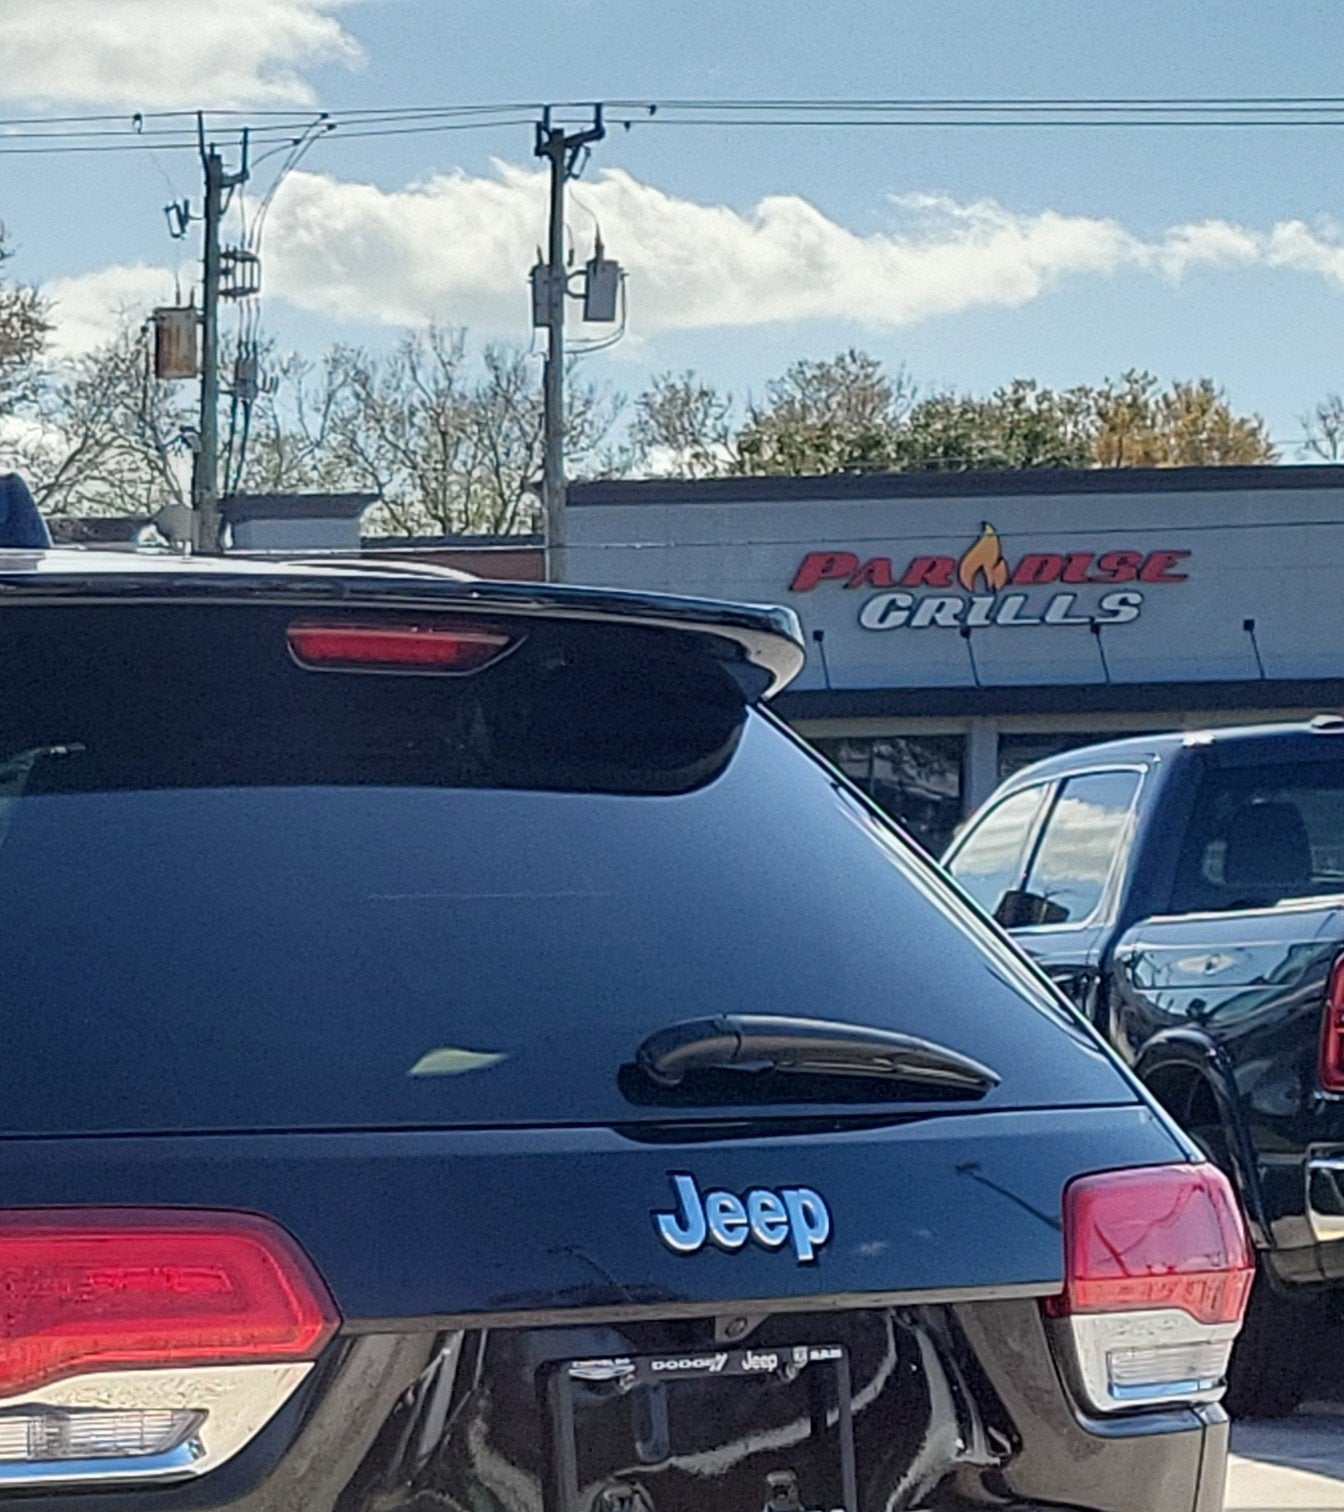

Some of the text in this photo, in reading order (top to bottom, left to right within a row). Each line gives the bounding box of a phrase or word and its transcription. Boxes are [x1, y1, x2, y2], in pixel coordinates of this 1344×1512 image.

[858, 590, 1144, 631] GRILLS
[652, 1171, 831, 1264] Jeep
[740, 1350, 778, 1372] Jeep
